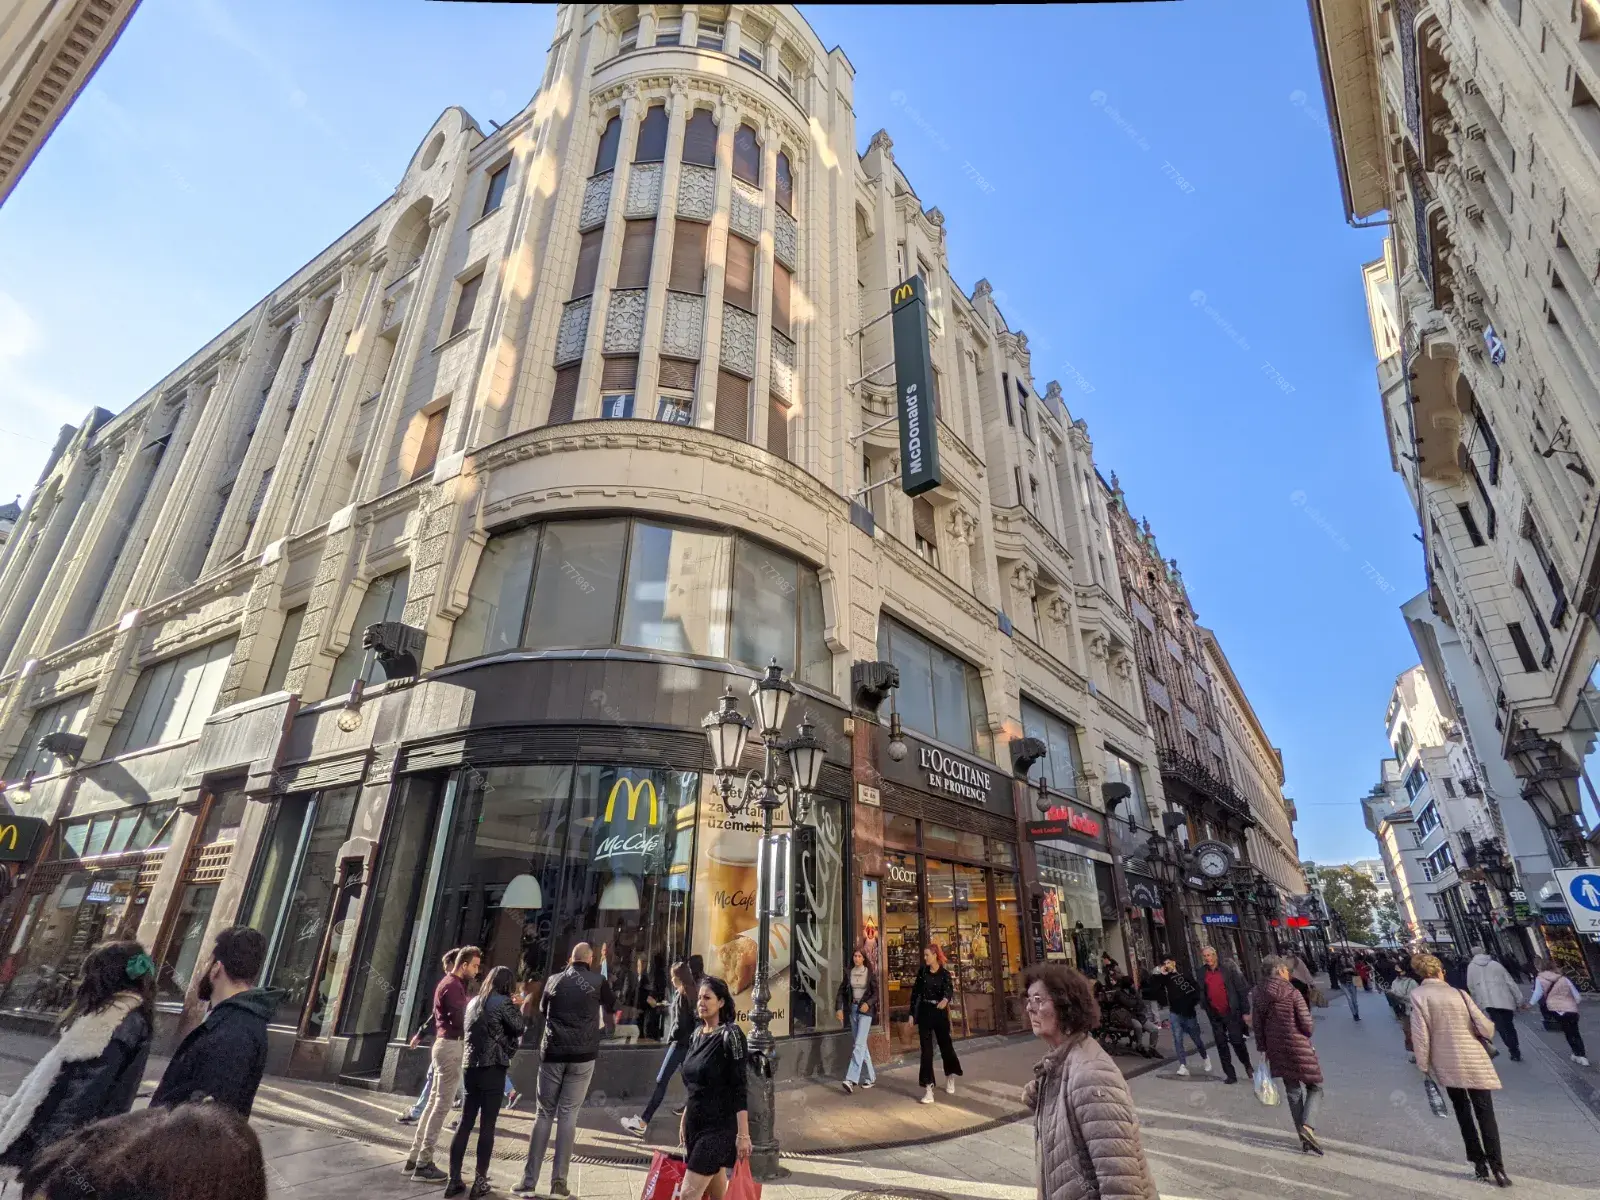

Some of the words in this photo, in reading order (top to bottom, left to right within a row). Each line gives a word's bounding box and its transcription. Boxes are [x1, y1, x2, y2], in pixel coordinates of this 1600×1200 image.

[906, 383, 923, 475] McDonald's
[919, 747, 992, 791] L'OCCITANE
[929, 773, 942, 788] EN
[944, 777, 987, 803] PROVENCE
[707, 815, 759, 833] üzemel!
[594, 829, 660, 860] McCafé
[795, 799, 845, 1014] McCafé
[1205, 915, 1234, 923] Berlitz
